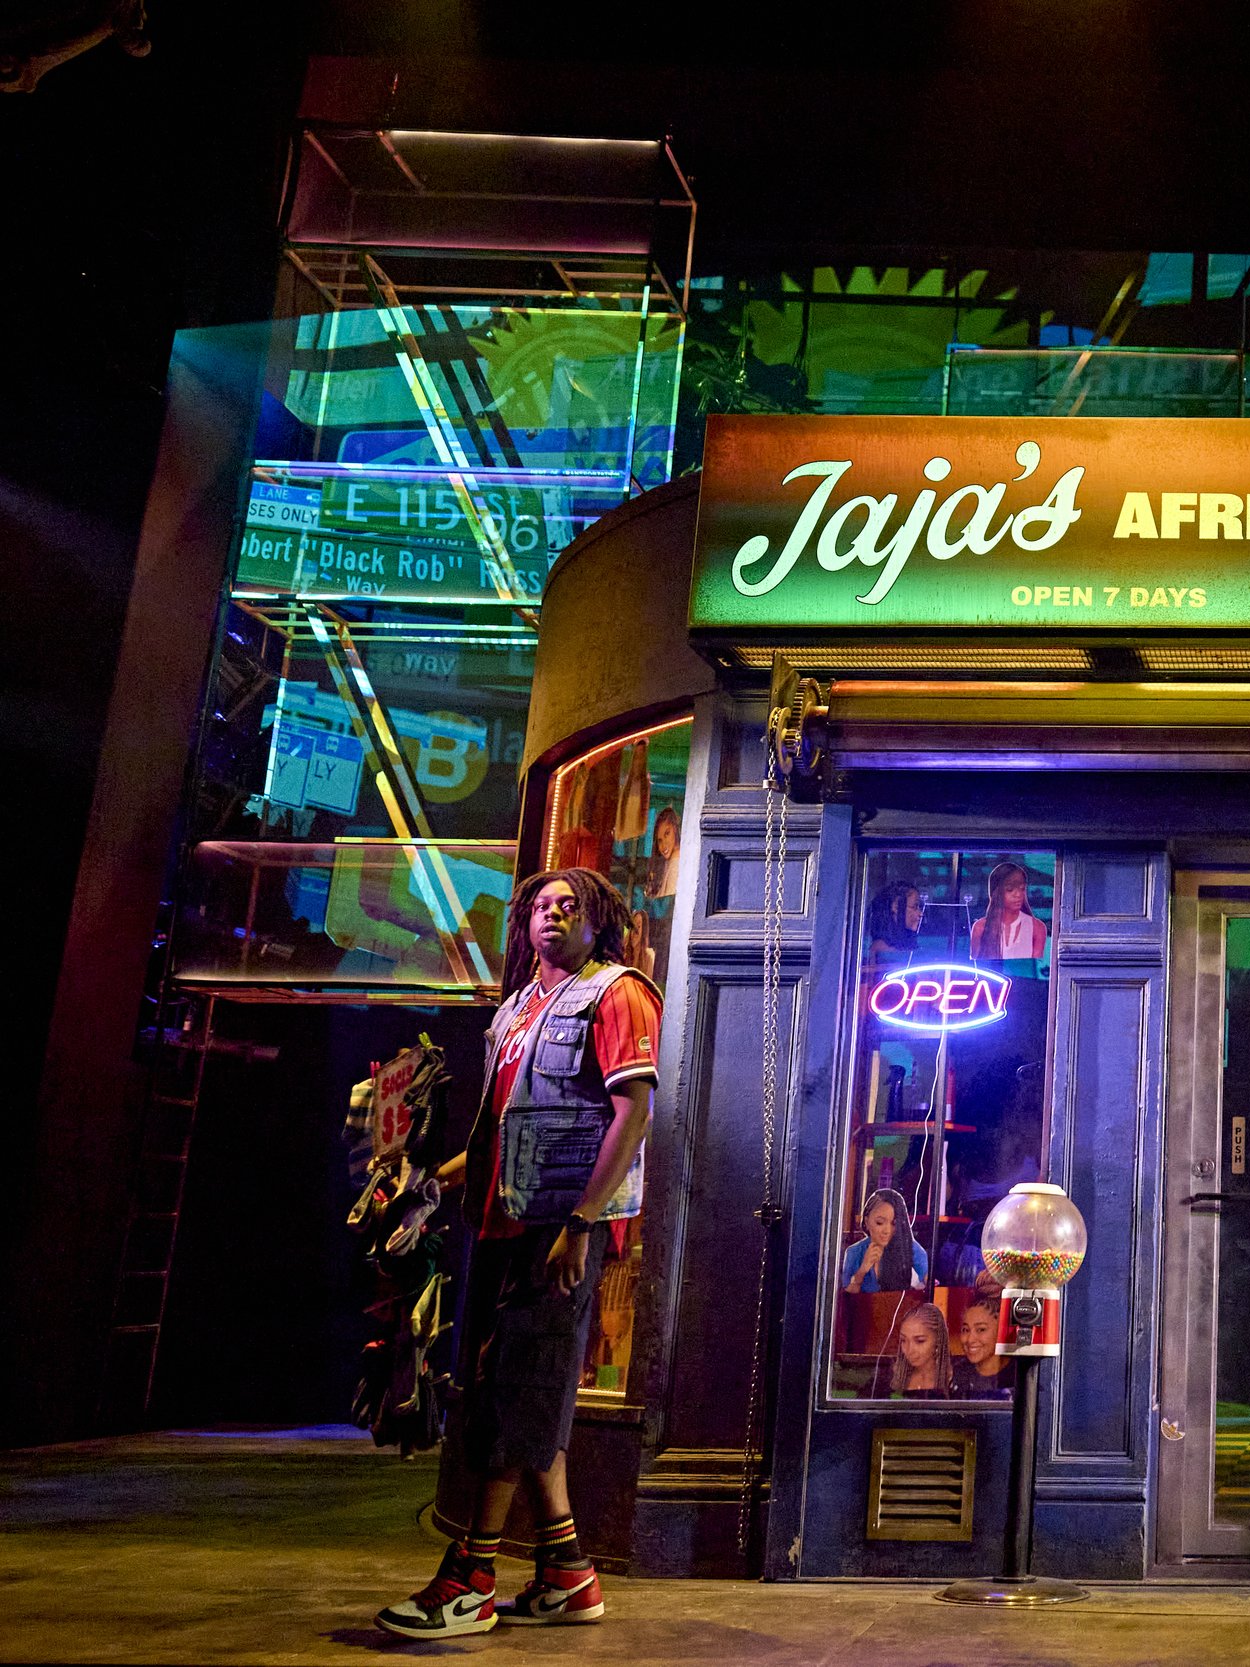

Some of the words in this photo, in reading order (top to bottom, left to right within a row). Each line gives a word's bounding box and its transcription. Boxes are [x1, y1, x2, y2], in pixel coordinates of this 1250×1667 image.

[258, 488, 288, 501] LANE
[345, 484, 372, 522] E
[396, 487, 461, 532] 115
[281, 507, 318, 526] ONLY
[731, 440, 1086, 606] Jaja's
[346, 575, 386, 597] Way
[1010, 585, 1092, 608] OPEN
[1103, 586, 1118, 607] 7
[1130, 586, 1208, 609] DAYS
[416, 735, 468, 788] B
[870, 978, 1009, 1016] OPEN
[1233, 1126, 1243, 1164] PUSH
